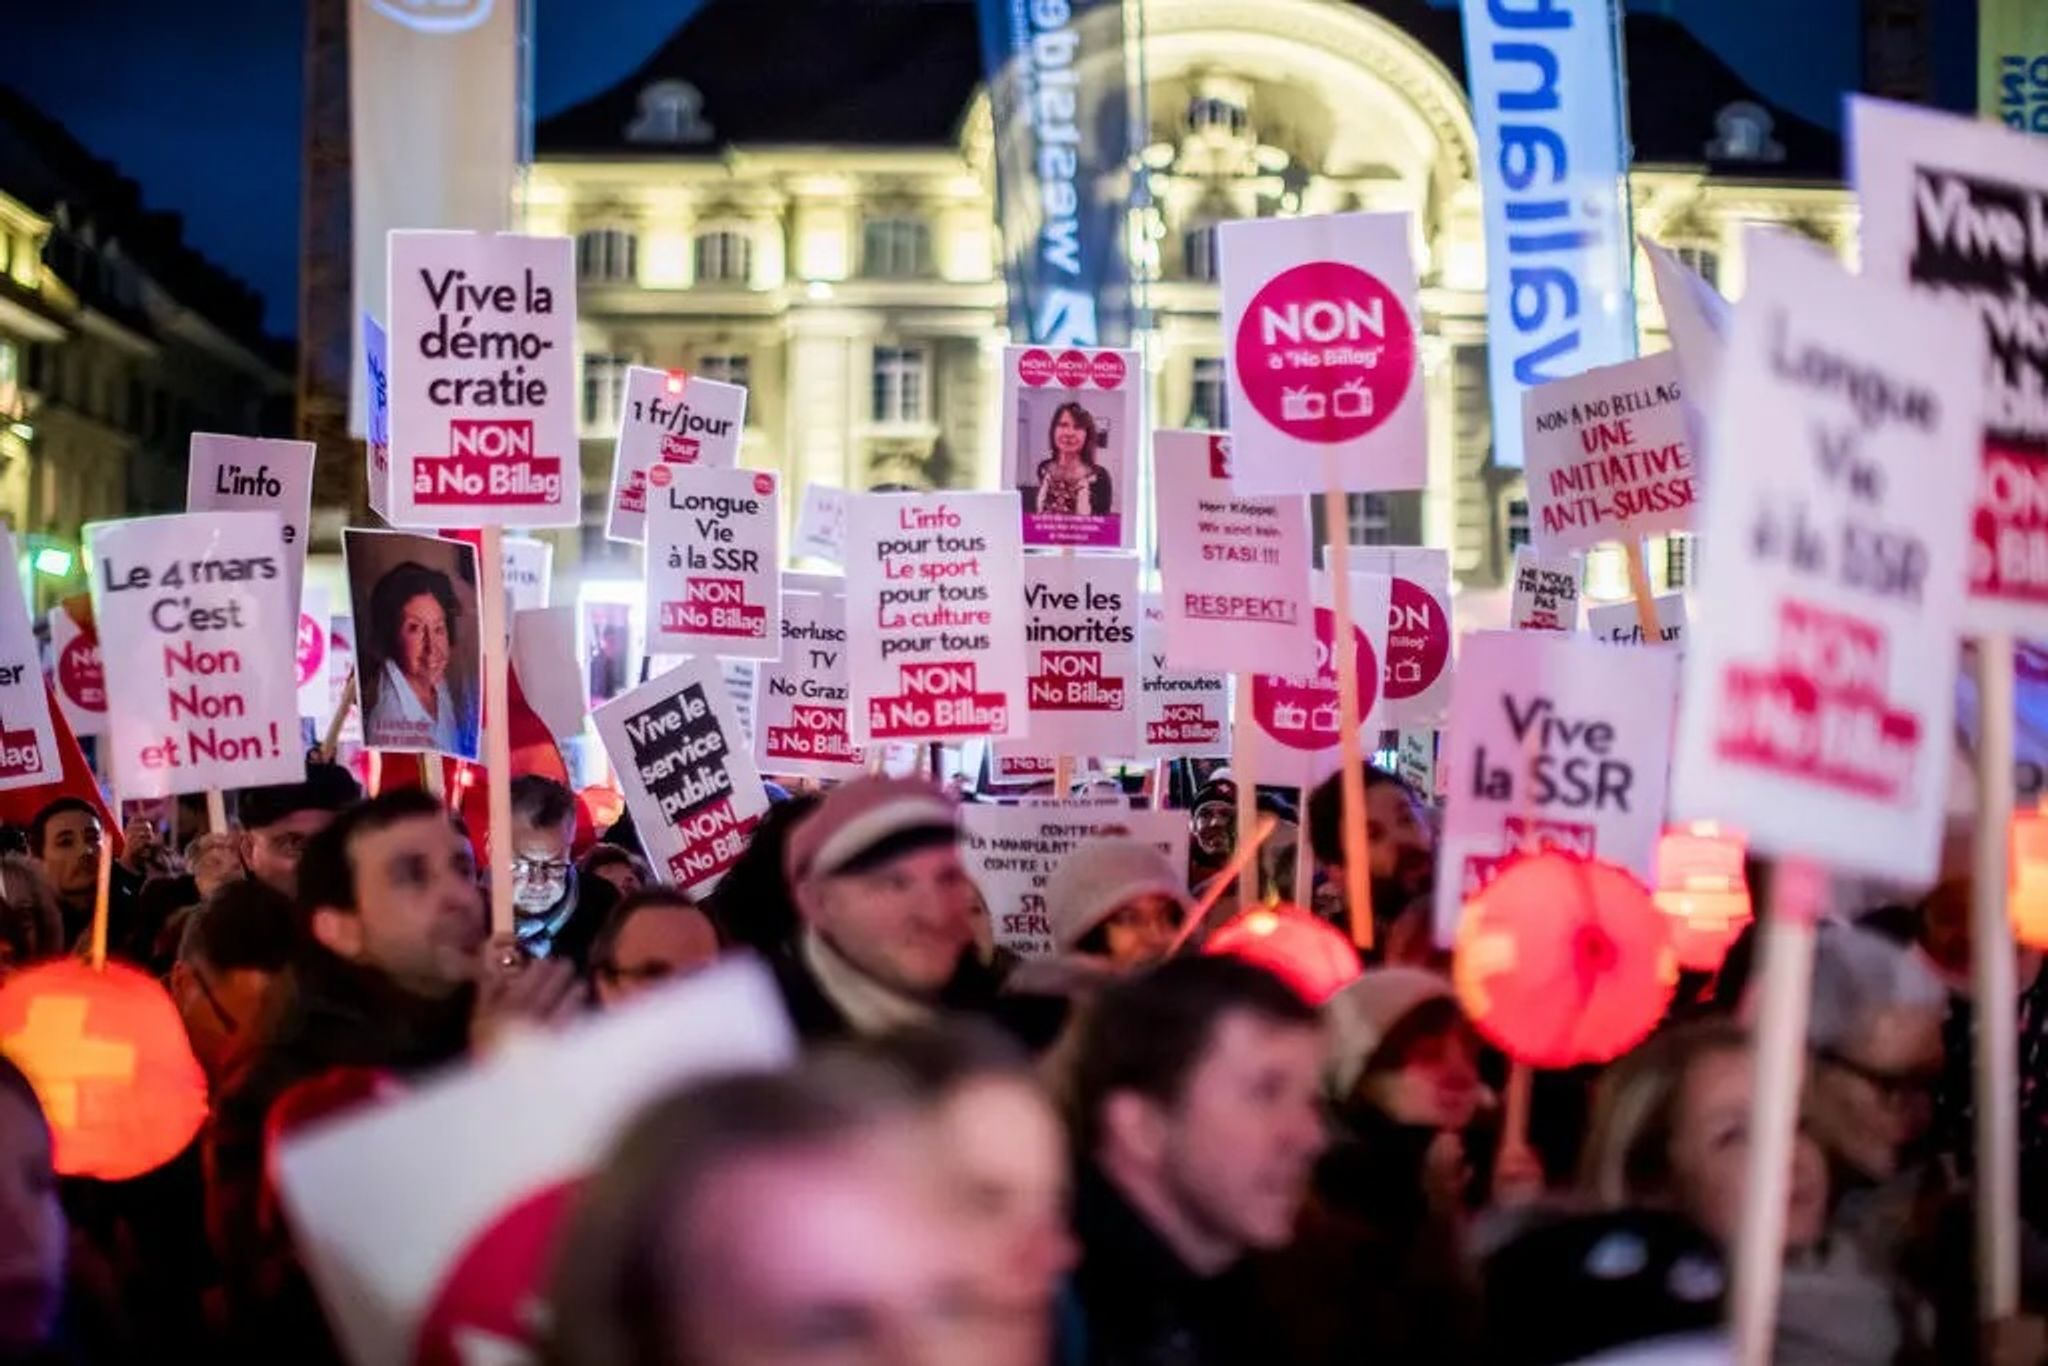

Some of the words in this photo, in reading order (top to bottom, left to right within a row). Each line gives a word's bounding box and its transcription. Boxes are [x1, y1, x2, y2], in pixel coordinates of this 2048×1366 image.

[419, 267, 517, 314] Vive
[525, 267, 554, 315] la
[419, 313, 554, 360] démo-
[1260, 297, 1386, 346] NON
[428, 365, 548, 407] cratie
[633, 401, 642, 421] 1
[650, 397, 733, 438] fr/jour
[1536, 410, 1567, 432] NON
[1585, 400, 1610, 421] NO
[1611, 382, 1681, 416] BILLAG
[452, 426, 530, 458] NON
[1581, 418, 1636, 454] UNE
[215, 463, 282, 497] L'info
[414, 464, 433, 494] à
[438, 464, 484, 496] No
[489, 463, 561, 503] Billag
[1549, 442, 1691, 497] INITIATIVE
[669, 487, 760, 519] Longue
[900, 504, 962, 530] L'info
[695, 518, 734, 543] Vie
[668, 545, 682, 569] à
[687, 545, 707, 570] la
[712, 547, 759, 574] SSR
[877, 535, 931, 561] pour
[937, 534, 987, 554] tous
[1203, 544, 1258, 562] STASI
[103, 557, 151, 593] Le
[160, 561, 185, 590] 4
[191, 555, 278, 583] mars
[885, 558, 915, 580] Le
[920, 557, 980, 582] sport
[687, 582, 742, 604] NON
[880, 585, 933, 609] pour
[939, 582, 989, 602] tous
[1022, 583, 1080, 611] Vive
[1085, 582, 1122, 611] les
[1185, 594, 1285, 617] RESPEKT
[1533, 594, 1558, 611] PAS
[150, 597, 245, 633] C'est
[677, 607, 708, 628] No
[711, 608, 766, 637] Billag
[878, 606, 906, 629] La
[911, 602, 992, 628] culture
[163, 640, 242, 678] Non
[809, 650, 837, 669] TV
[881, 635, 935, 660] pour
[940, 632, 991, 651] tous
[902, 667, 972, 694] NON
[1041, 655, 1099, 676] NON
[769, 677, 797, 698] No
[1032, 685, 1064, 703] No
[1067, 683, 1123, 709] Billag
[1142, 675, 1222, 693] inforoutes
[168, 684, 246, 722] Non
[871, 702, 886, 730] à
[891, 702, 931, 729] No
[934, 698, 1007, 734] Billag
[1163, 706, 1202, 721] NON
[626, 709, 682, 747] Vive
[679, 693, 706, 724] le
[794, 709, 845, 730] NON
[1158, 726, 1179, 739] No
[1182, 726, 1220, 743] Billag
[1503, 694, 1615, 752] Vive
[140, 736, 181, 769] et
[188, 728, 263, 765] Non
[641, 730, 722, 786] service
[782, 733, 810, 753] No
[814, 735, 865, 764] Billag
[661, 767, 730, 822] public
[1473, 745, 1512, 800] la
[1532, 755, 1634, 814] SSR
[681, 803, 734, 847] NON
[671, 861, 687, 884] à
[684, 852, 715, 878] No
[983, 858, 1038, 872] CONTRE
